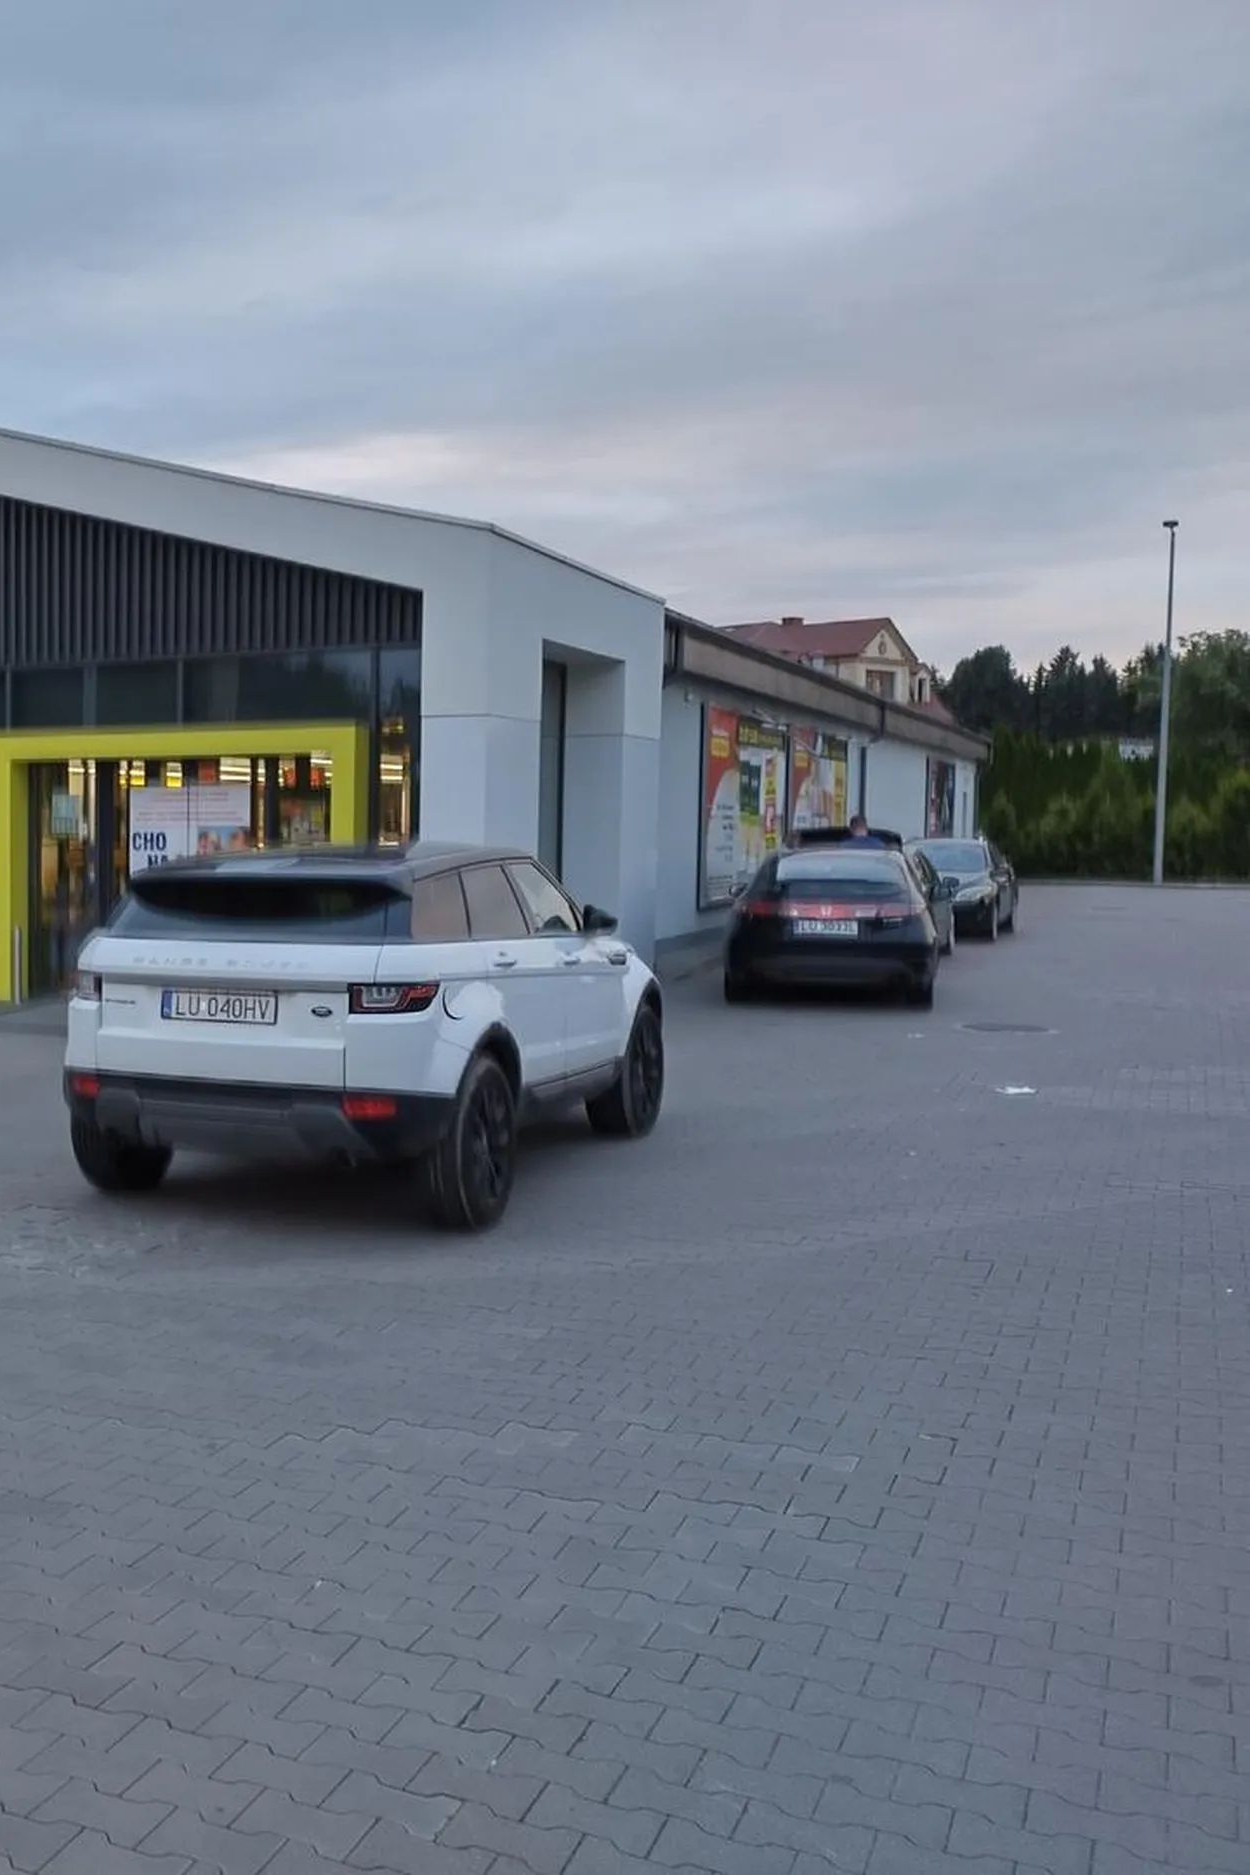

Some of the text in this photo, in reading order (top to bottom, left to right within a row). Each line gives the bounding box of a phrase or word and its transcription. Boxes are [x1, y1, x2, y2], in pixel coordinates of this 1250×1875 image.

[132, 832, 167, 851] CHO
[175, 992, 271, 1020] LU 040HV
